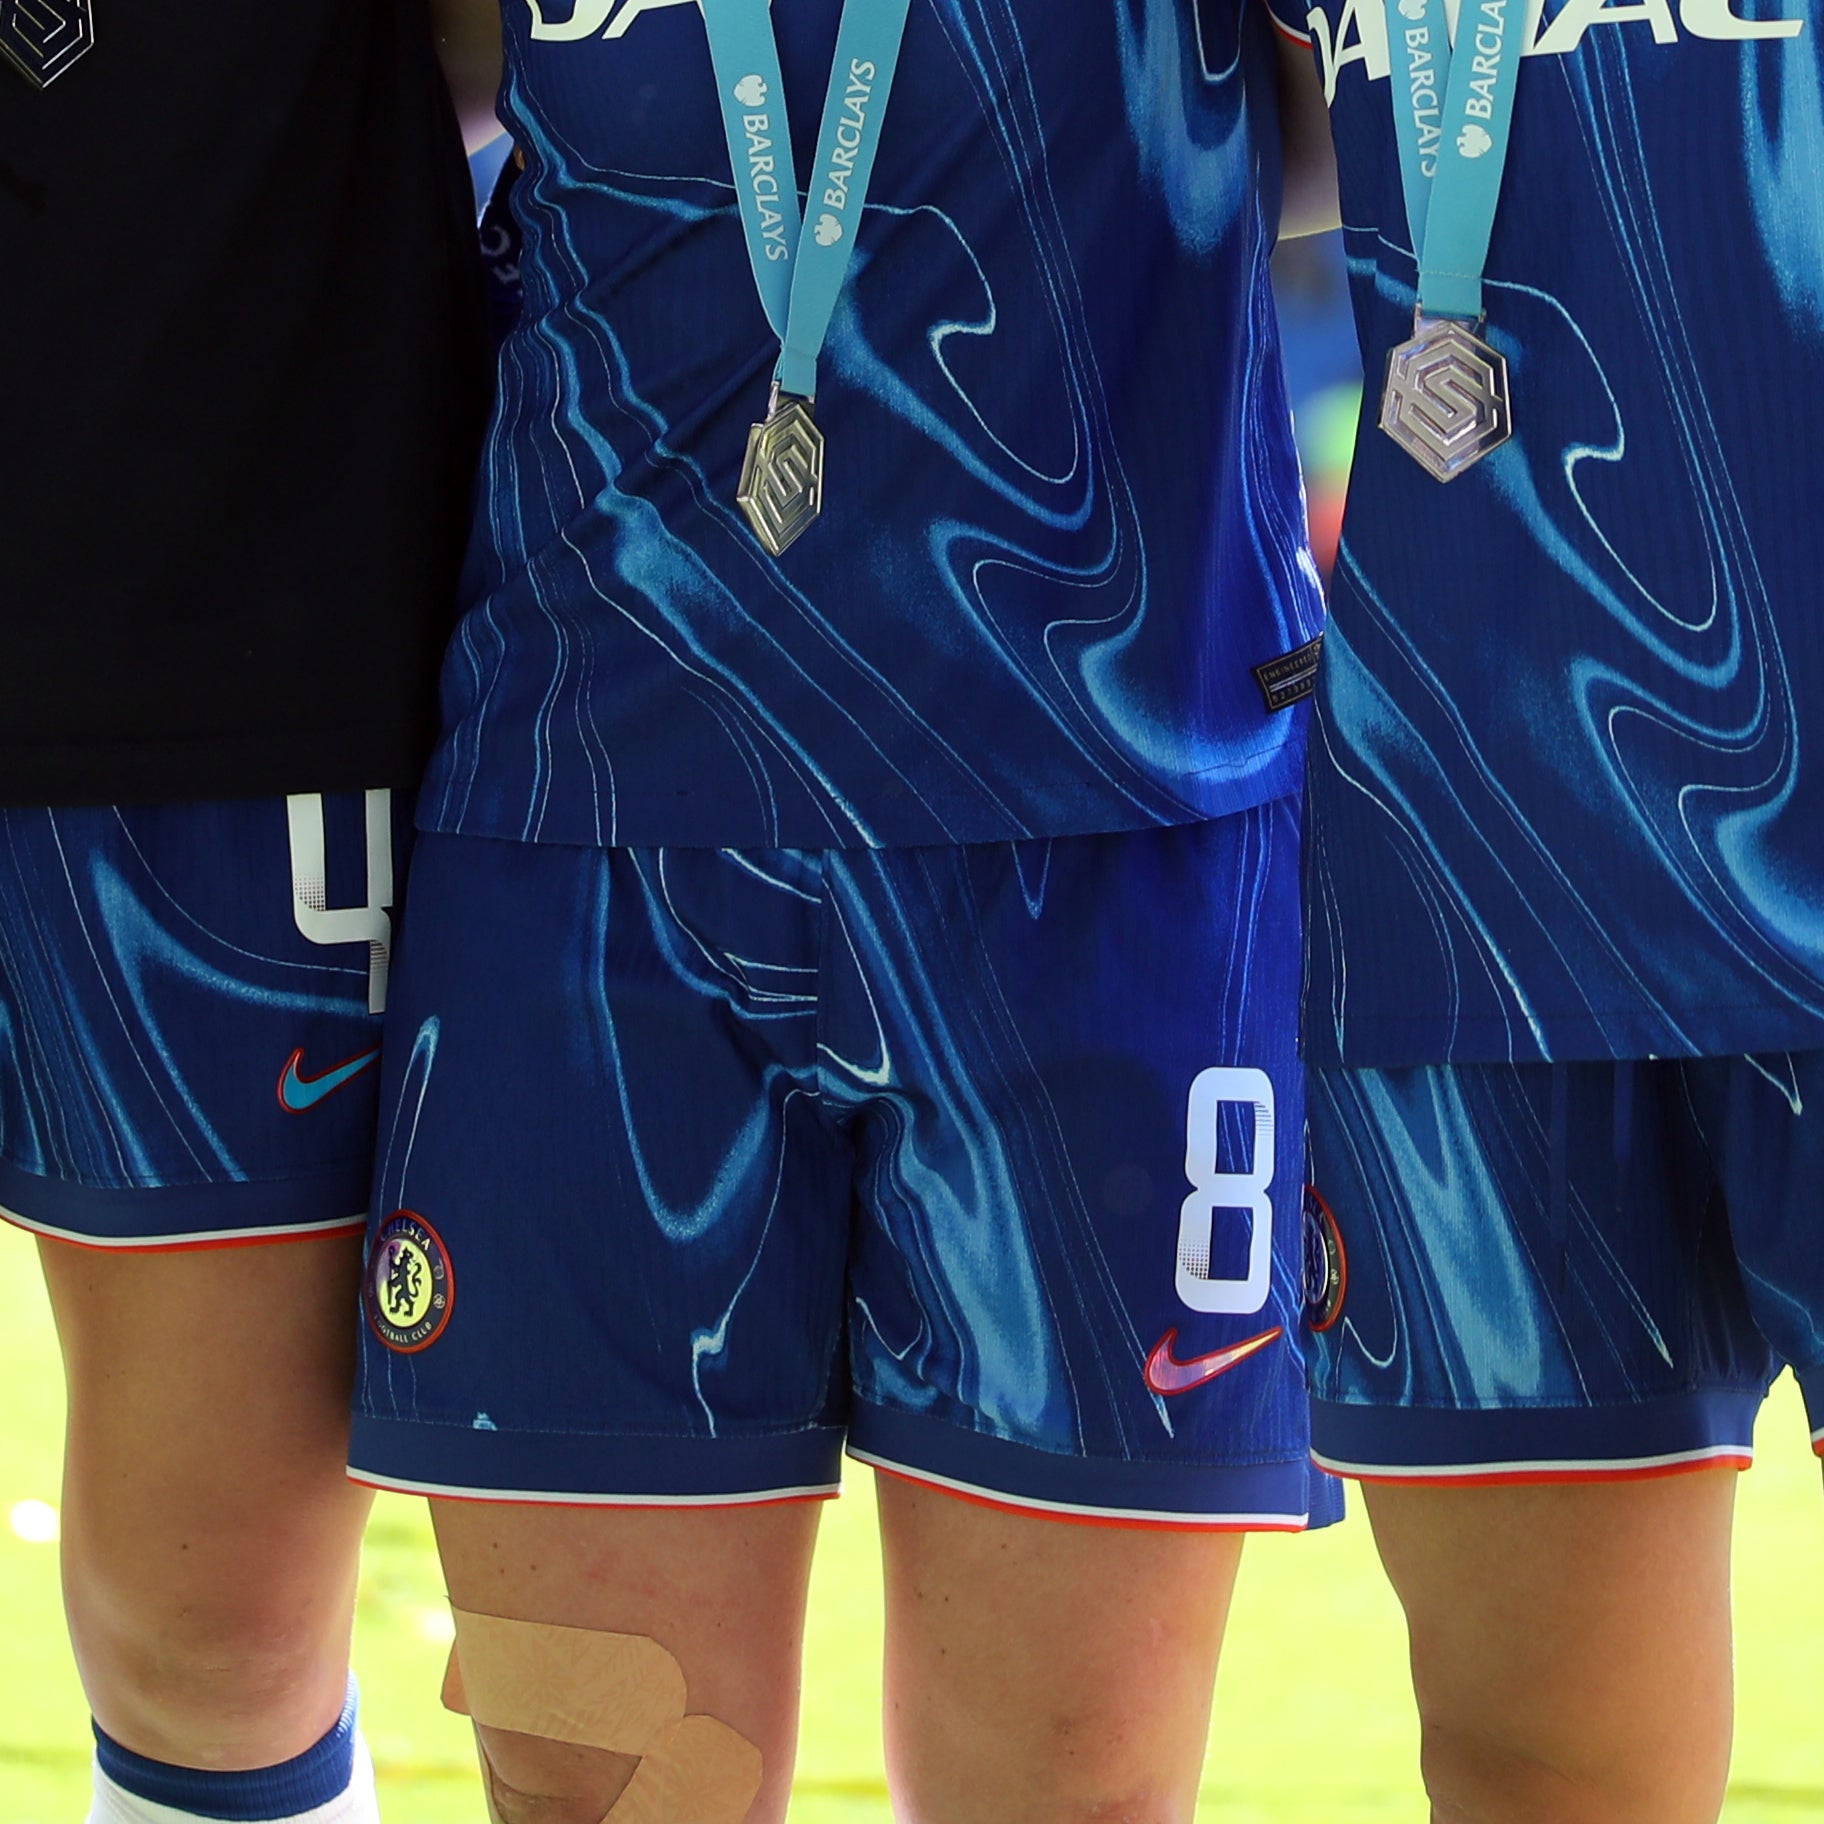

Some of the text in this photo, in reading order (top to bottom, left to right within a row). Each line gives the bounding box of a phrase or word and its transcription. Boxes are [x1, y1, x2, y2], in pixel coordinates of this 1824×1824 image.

[743, 113, 789, 263] BARCLAYS
[822, 57, 876, 211] BARCLAYS
[286, 788, 394, 1014] 4
[381, 1218, 431, 1251] CHELSEA
[1176, 1067, 1275, 1315] 8
